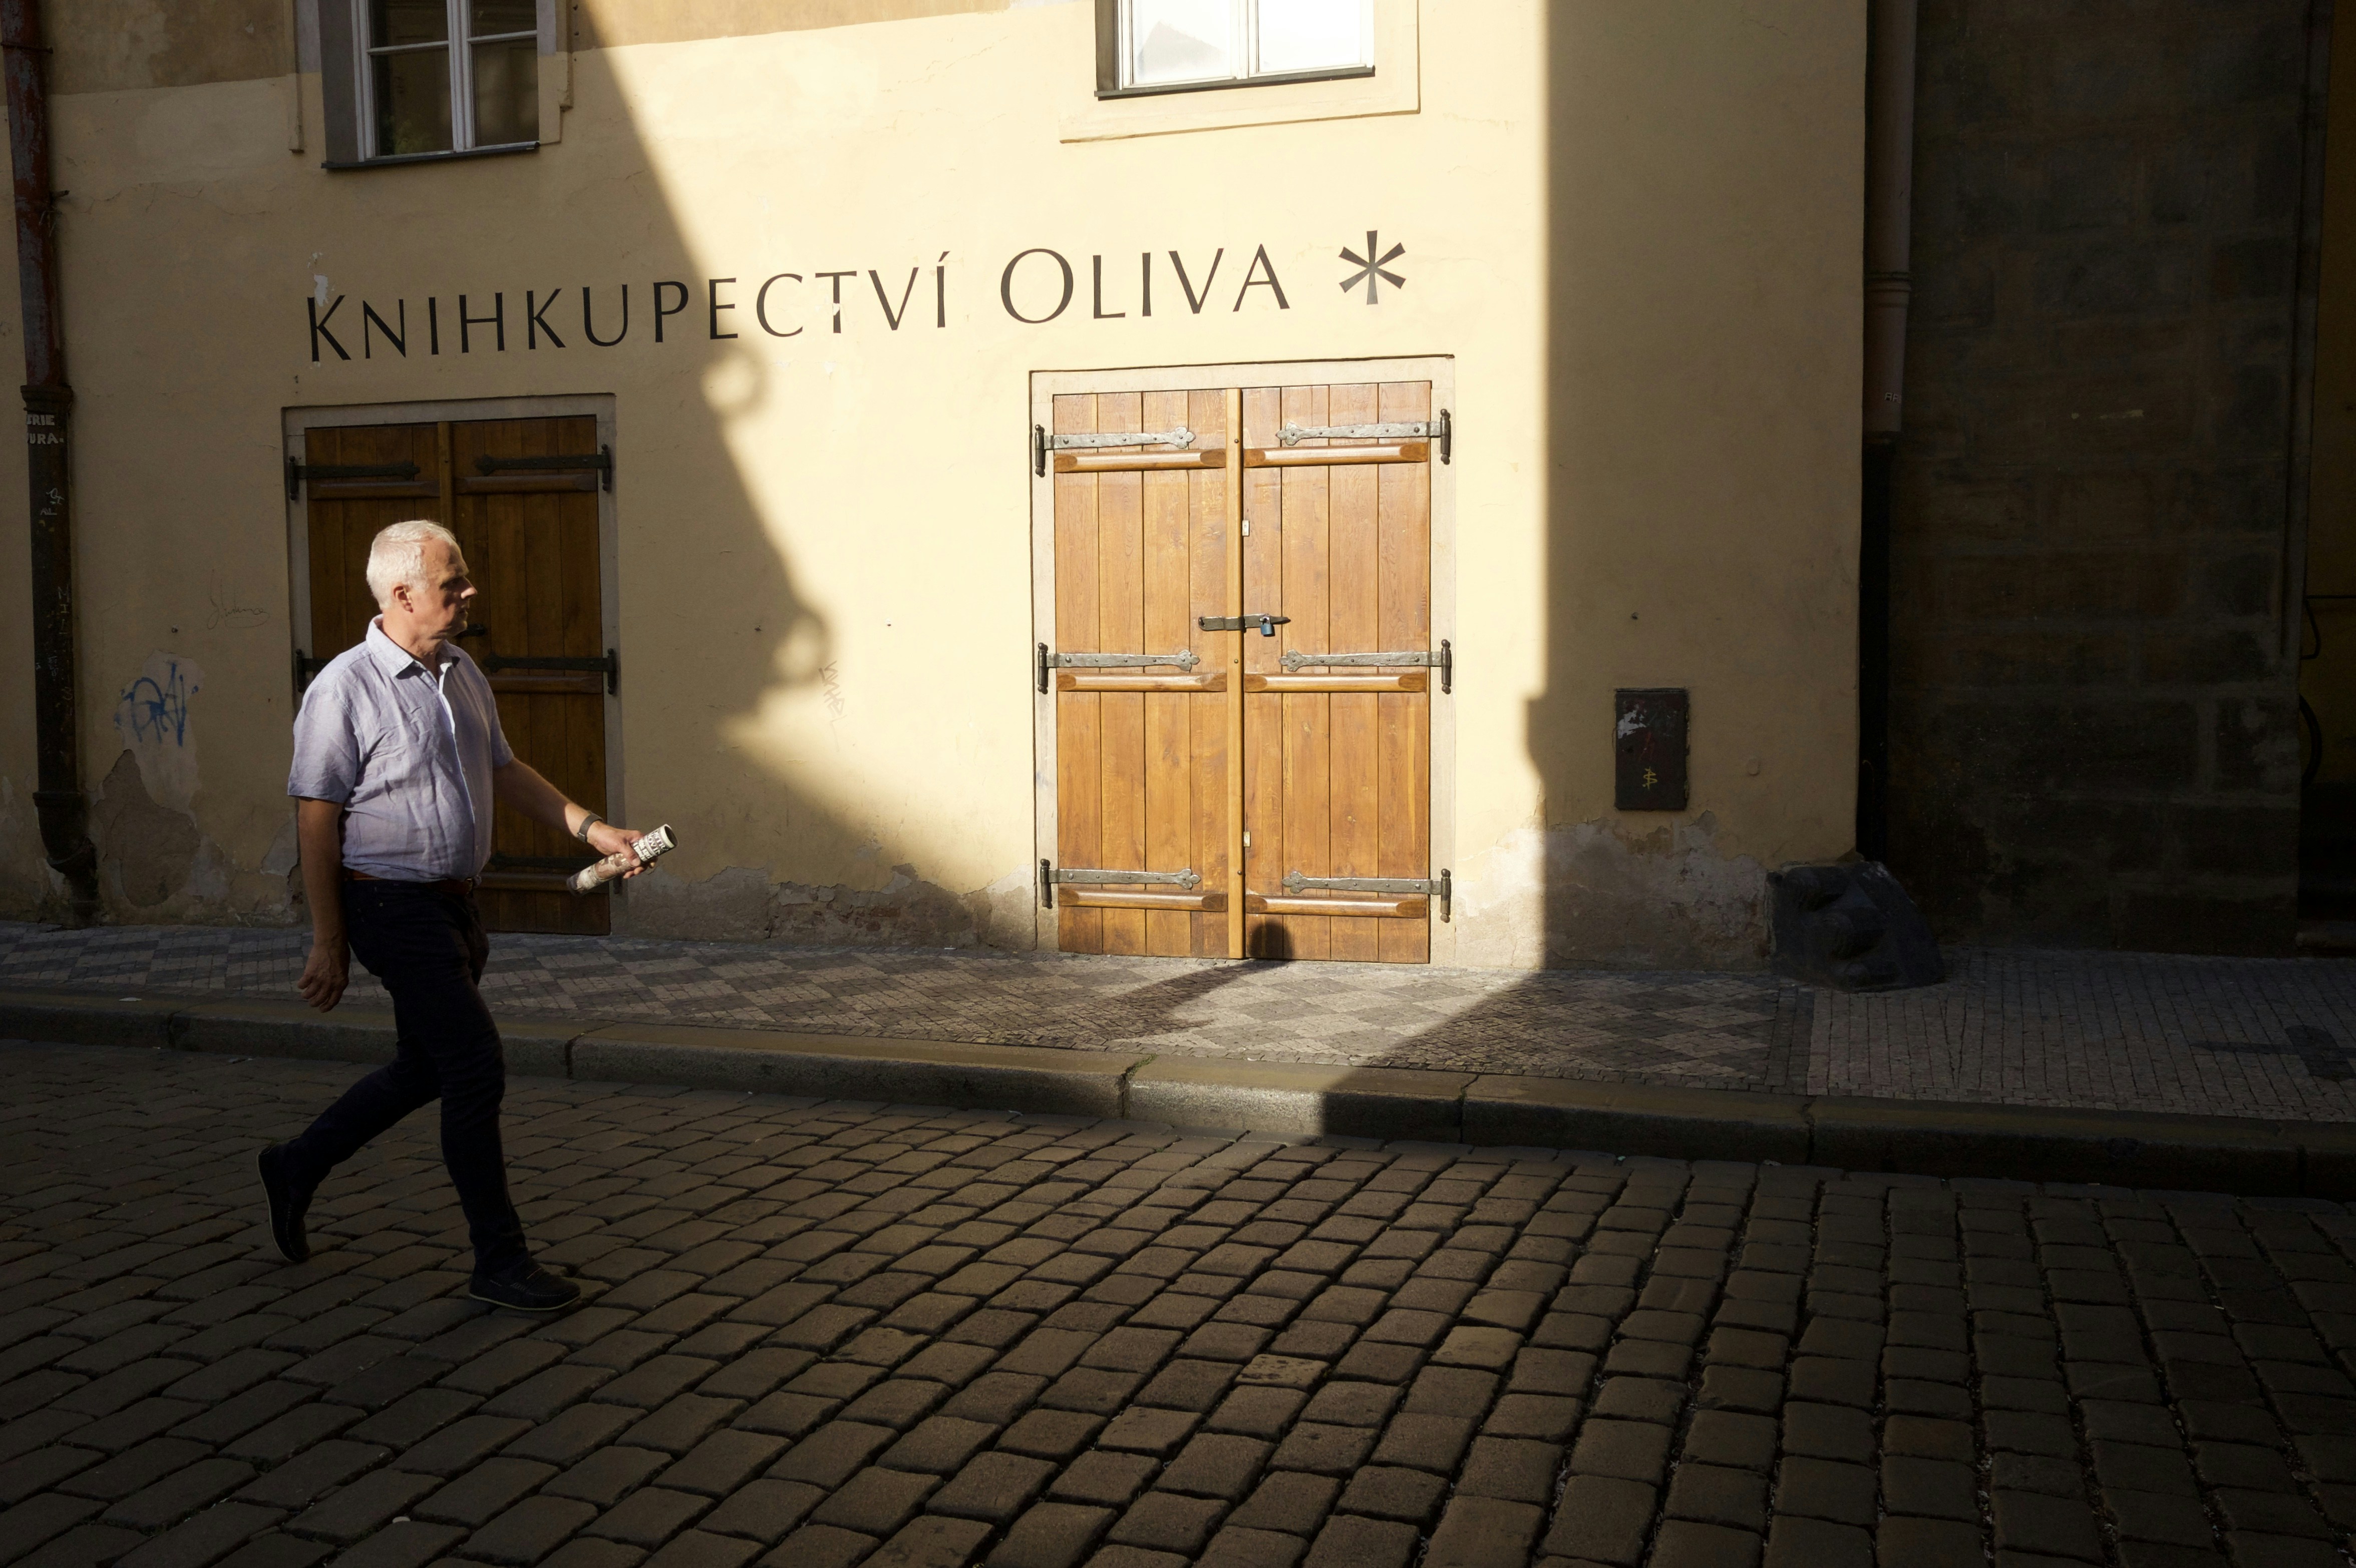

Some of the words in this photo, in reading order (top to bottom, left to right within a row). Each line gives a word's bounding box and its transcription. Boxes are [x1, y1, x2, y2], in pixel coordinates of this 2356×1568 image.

[308, 252, 949, 362] KNIHKUPECTVÍ
[1001, 245, 1290, 324] OLIVA
[27, 433, 64, 445] URA.
